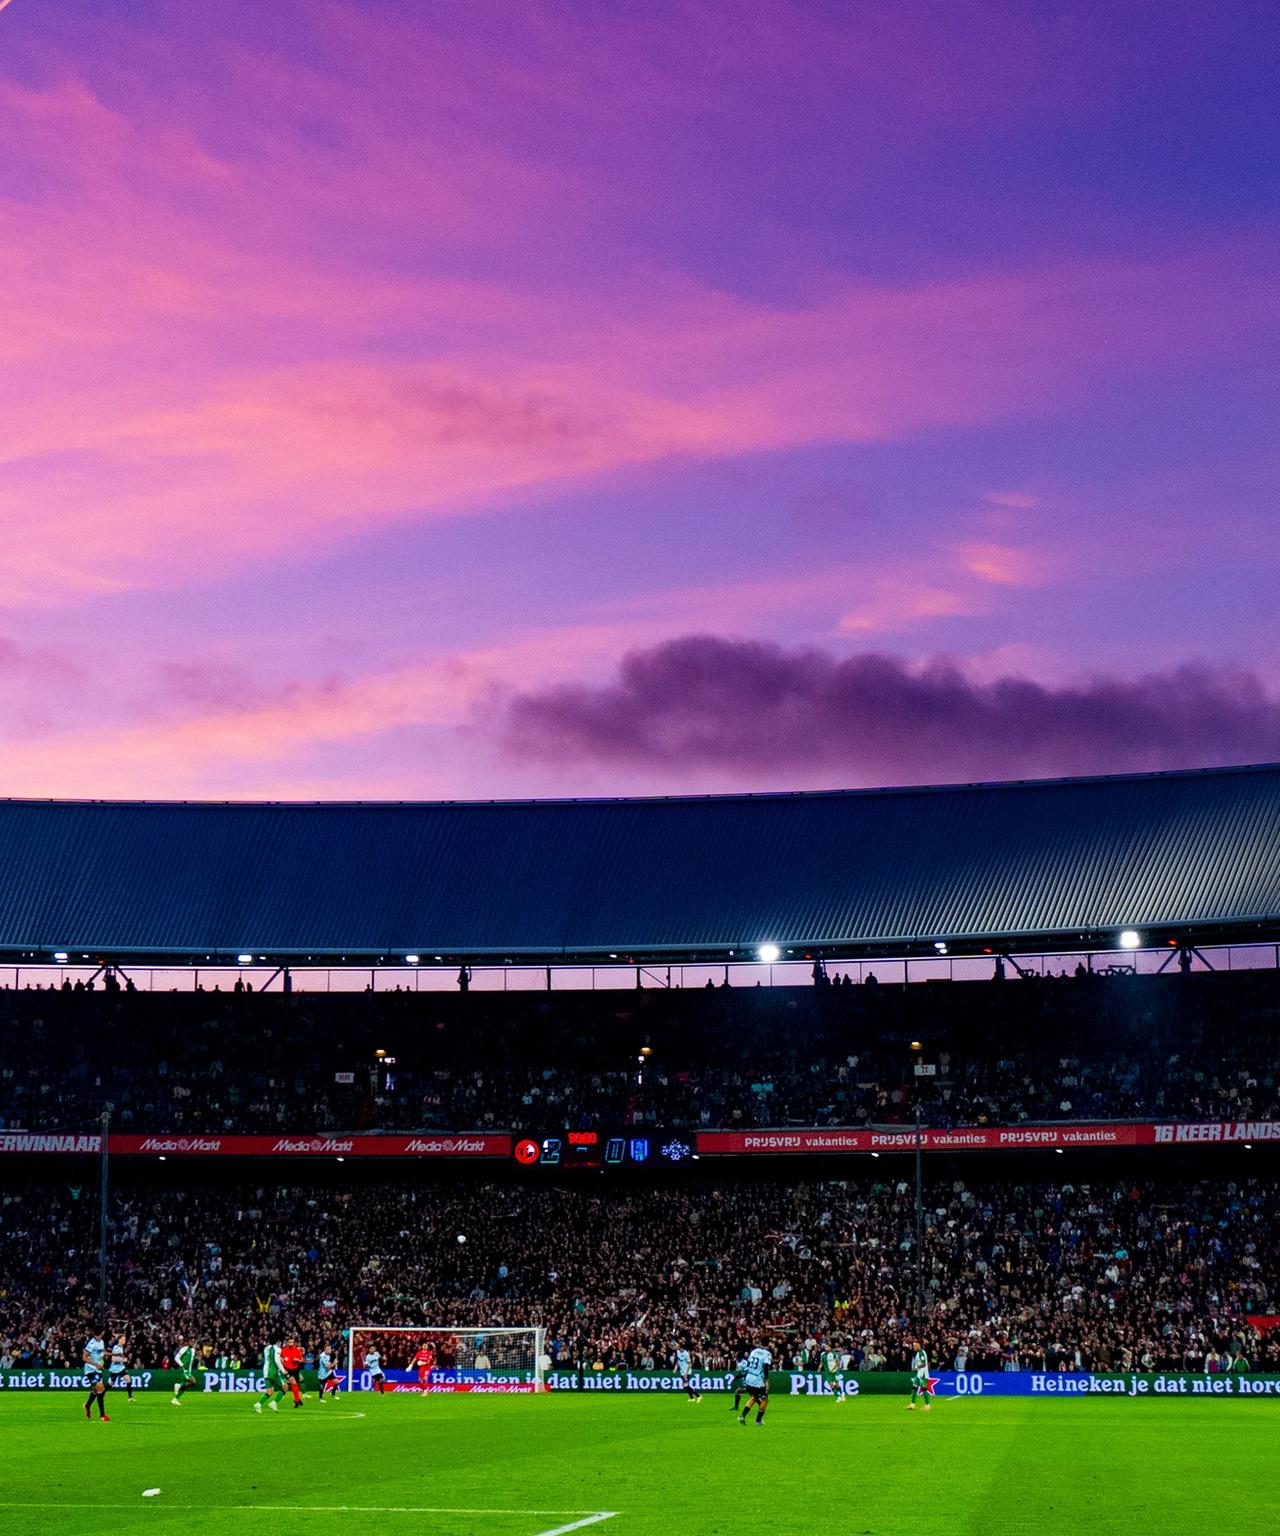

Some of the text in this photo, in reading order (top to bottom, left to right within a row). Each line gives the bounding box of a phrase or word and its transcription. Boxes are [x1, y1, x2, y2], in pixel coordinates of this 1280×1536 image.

[933, 1133, 986, 1145] vakanties
[1000, 1130, 1116, 1143] PRIJSVRIJ vakanties
[1154, 1125, 1173, 1142] 16
[1176, 1124, 1221, 1141] KEER
[745, 1136, 858, 1148] PRIJSVRIJ vakanties
[9, 1372, 45, 1388] niet
[48, 1372, 91, 1388] hore
[203, 1372, 266, 1393] Pilsie
[548, 1373, 577, 1389] dat
[583, 1373, 621, 1389] niet
[626, 1373, 687, 1389] horen
[689, 1373, 734, 1390] dan?
[1031, 1375, 1125, 1392] Heineken
[1129, 1375, 1148, 1396] je
[1153, 1376, 1186, 1393] dat
[1192, 1376, 1233, 1393] niet
